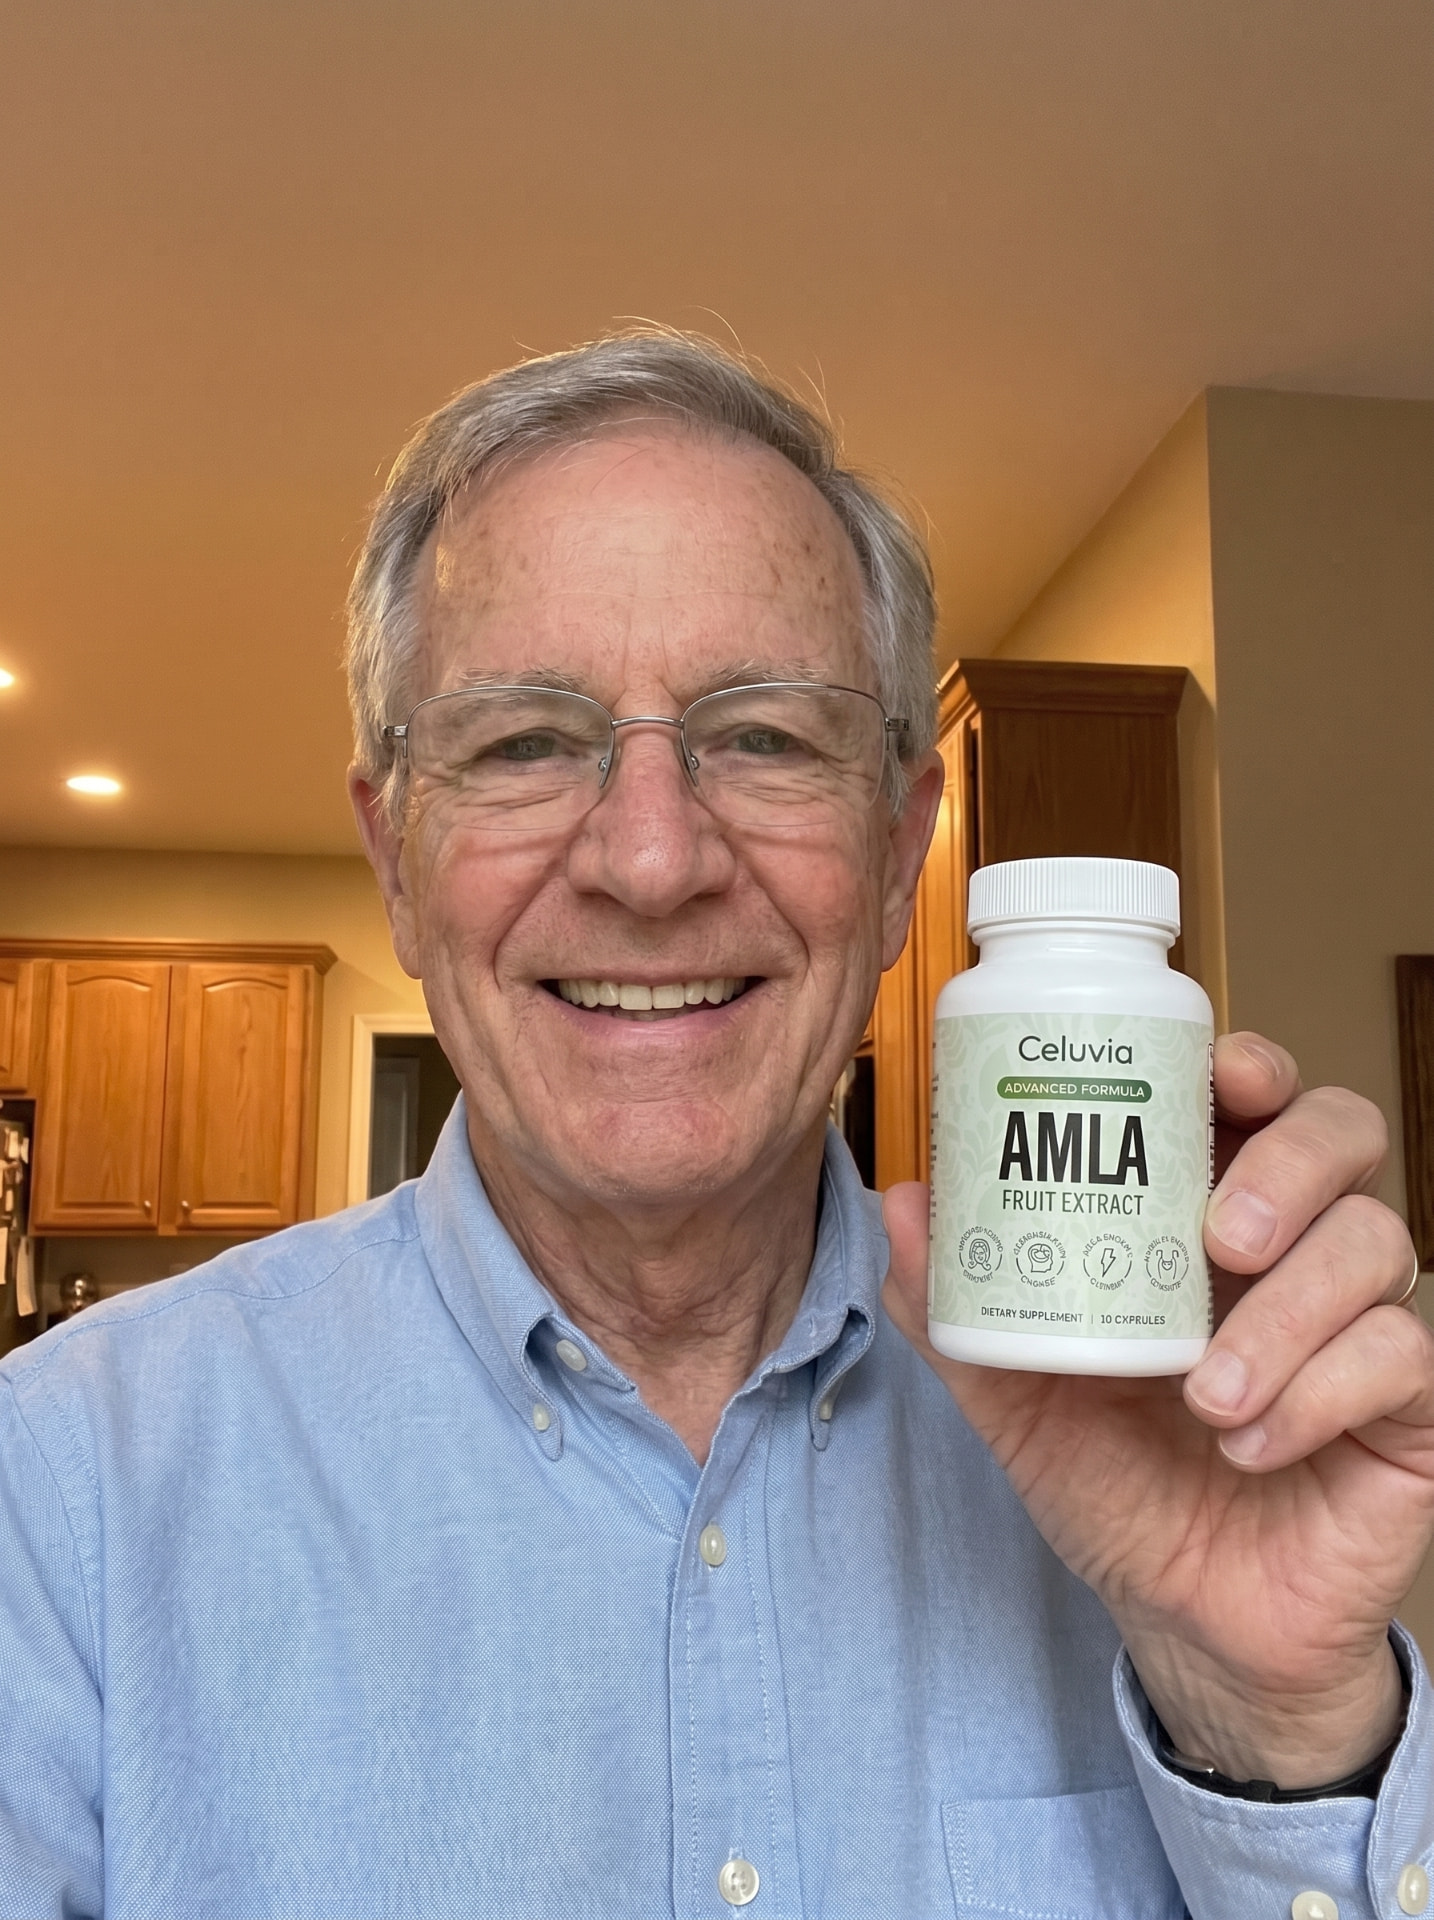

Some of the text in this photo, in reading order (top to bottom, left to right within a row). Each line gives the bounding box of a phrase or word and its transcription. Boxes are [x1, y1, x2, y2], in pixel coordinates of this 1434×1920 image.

[1018, 1035, 1133, 1065] Celuvia
[1004, 1083, 1145, 1098] ADVANCED FORMULA
[998, 1111, 1149, 1186] AMLA
[1002, 1189, 1144, 1216] FRUIT EXTRACT
[981, 1307, 1017, 1318] DIETARY
[1019, 1308, 1084, 1323] SUPPLEMENT
[1100, 1314, 1112, 1325] 10
